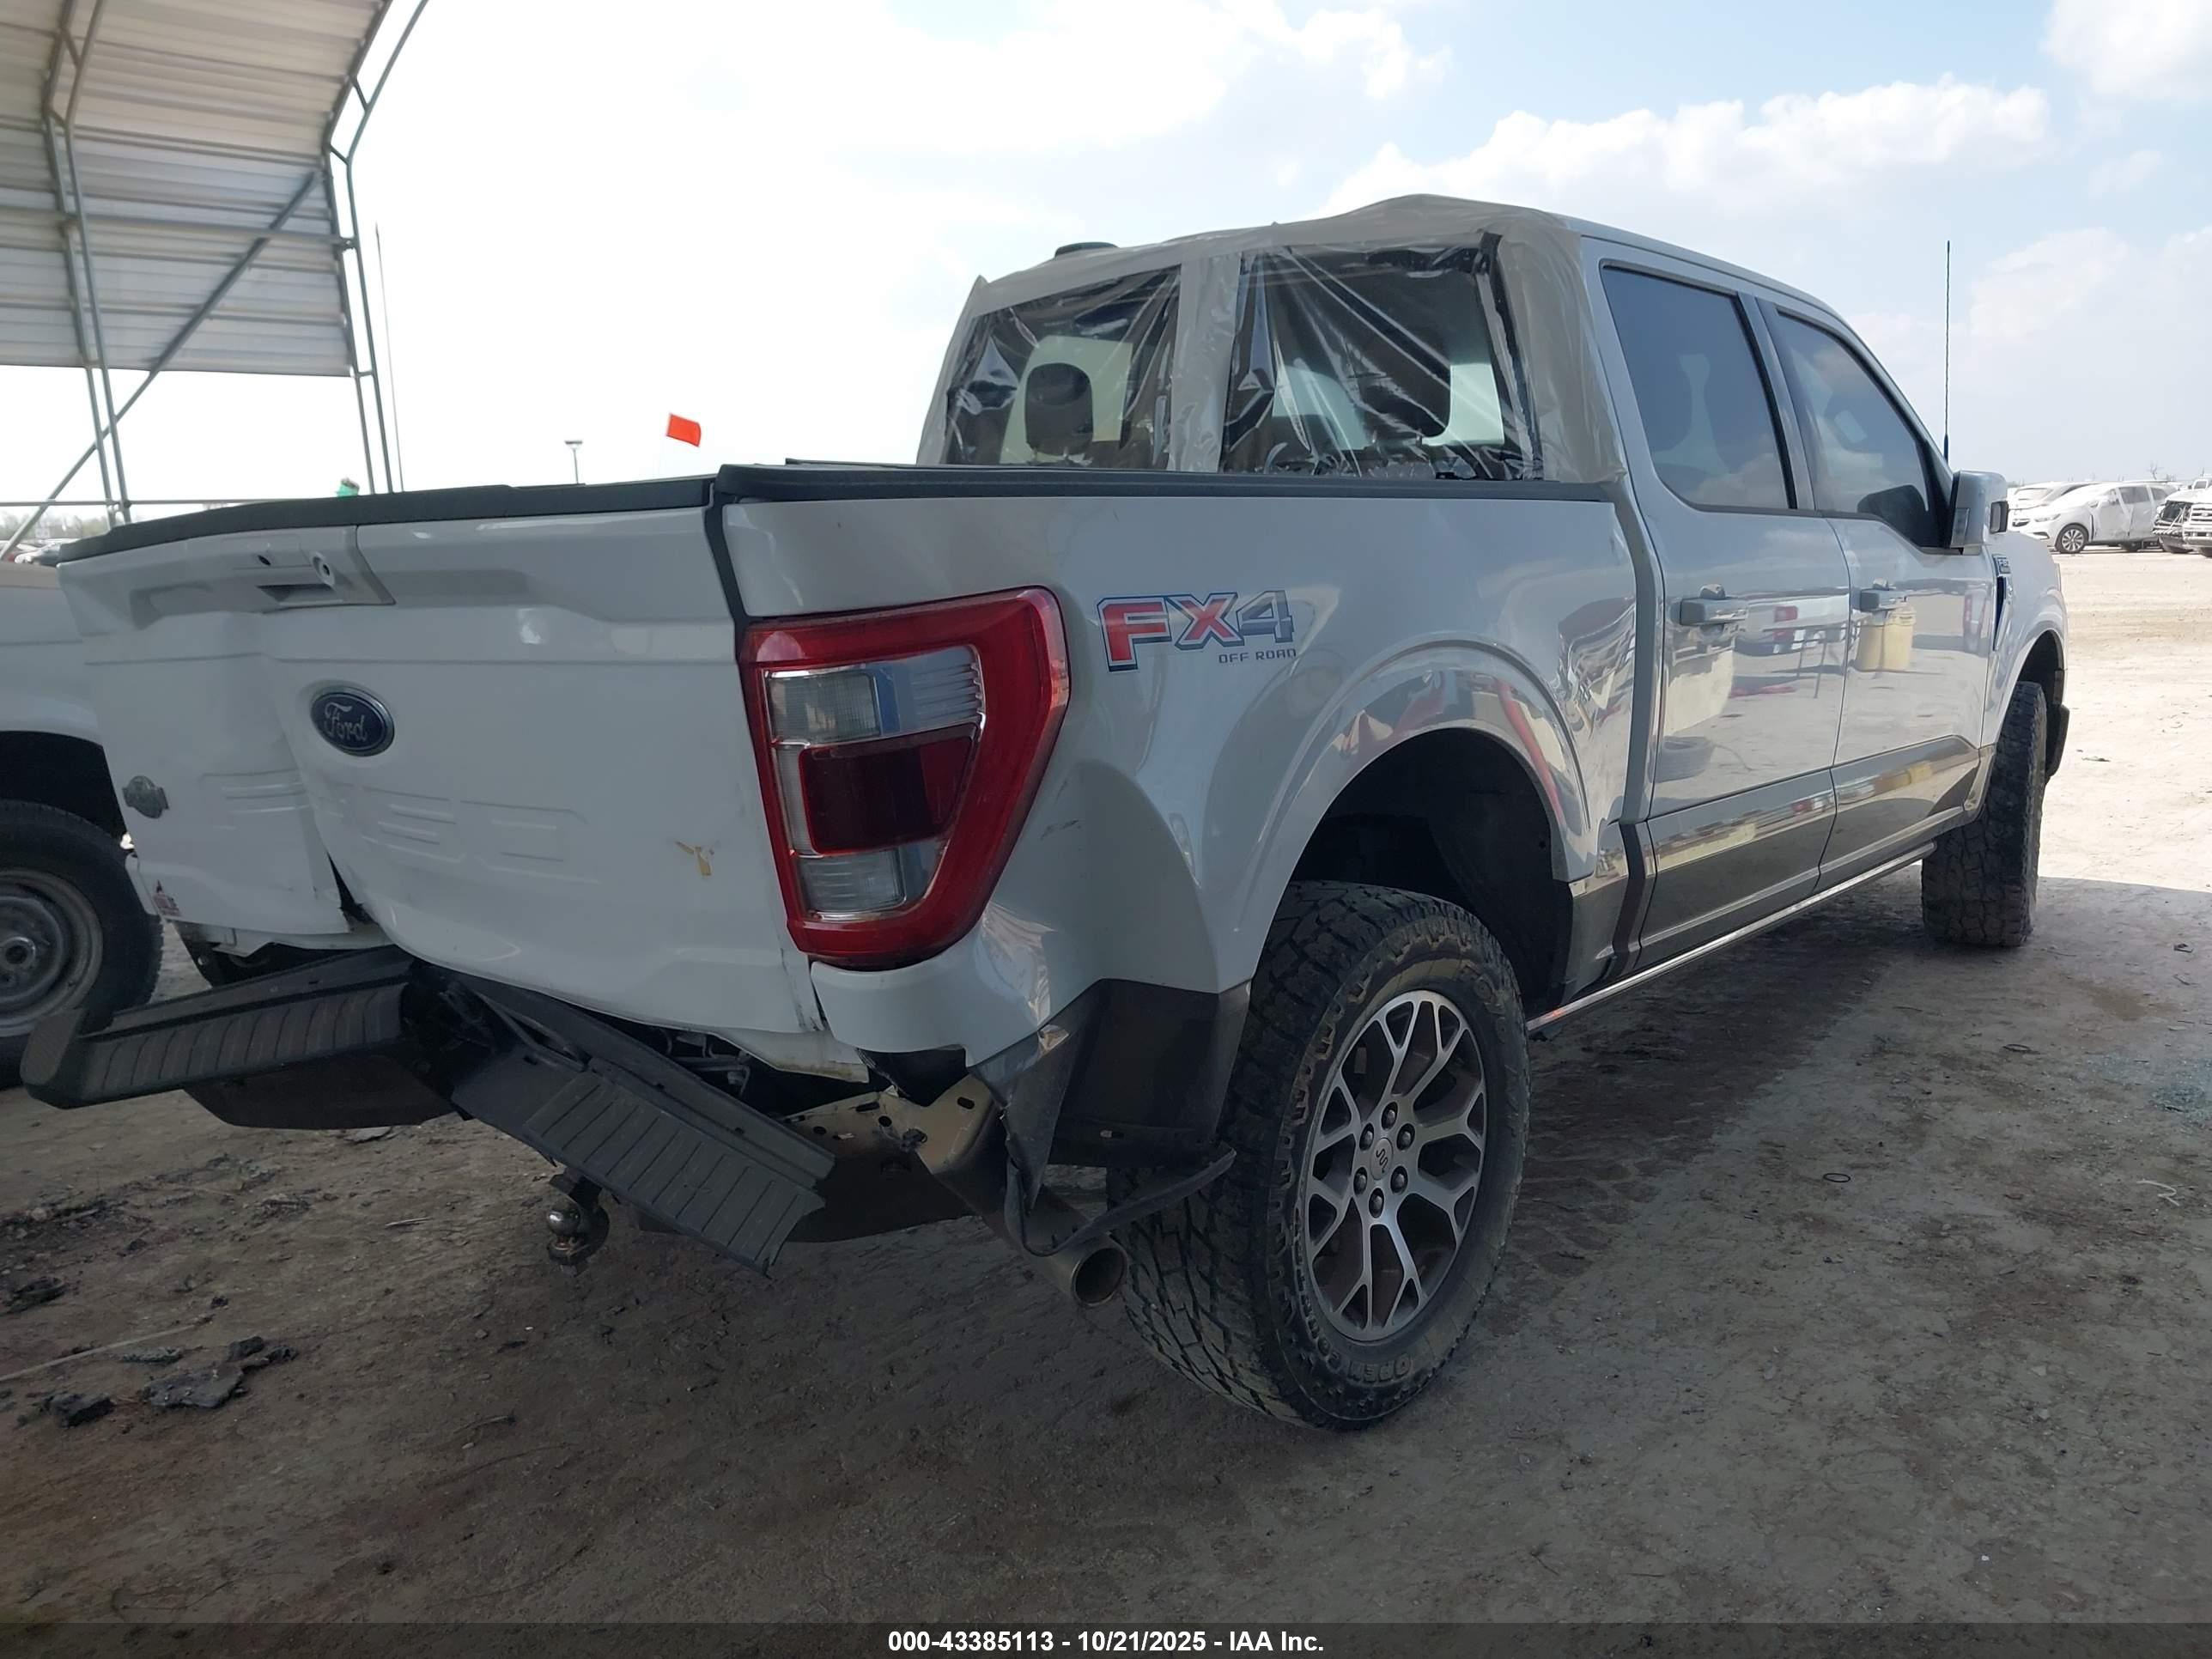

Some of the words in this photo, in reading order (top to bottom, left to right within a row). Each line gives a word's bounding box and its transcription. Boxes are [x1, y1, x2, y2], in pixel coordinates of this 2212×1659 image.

[1097, 589, 1295, 673] FX4
[1218, 651, 1250, 664] OFF
[1255, 647, 1297, 661] ROAD
